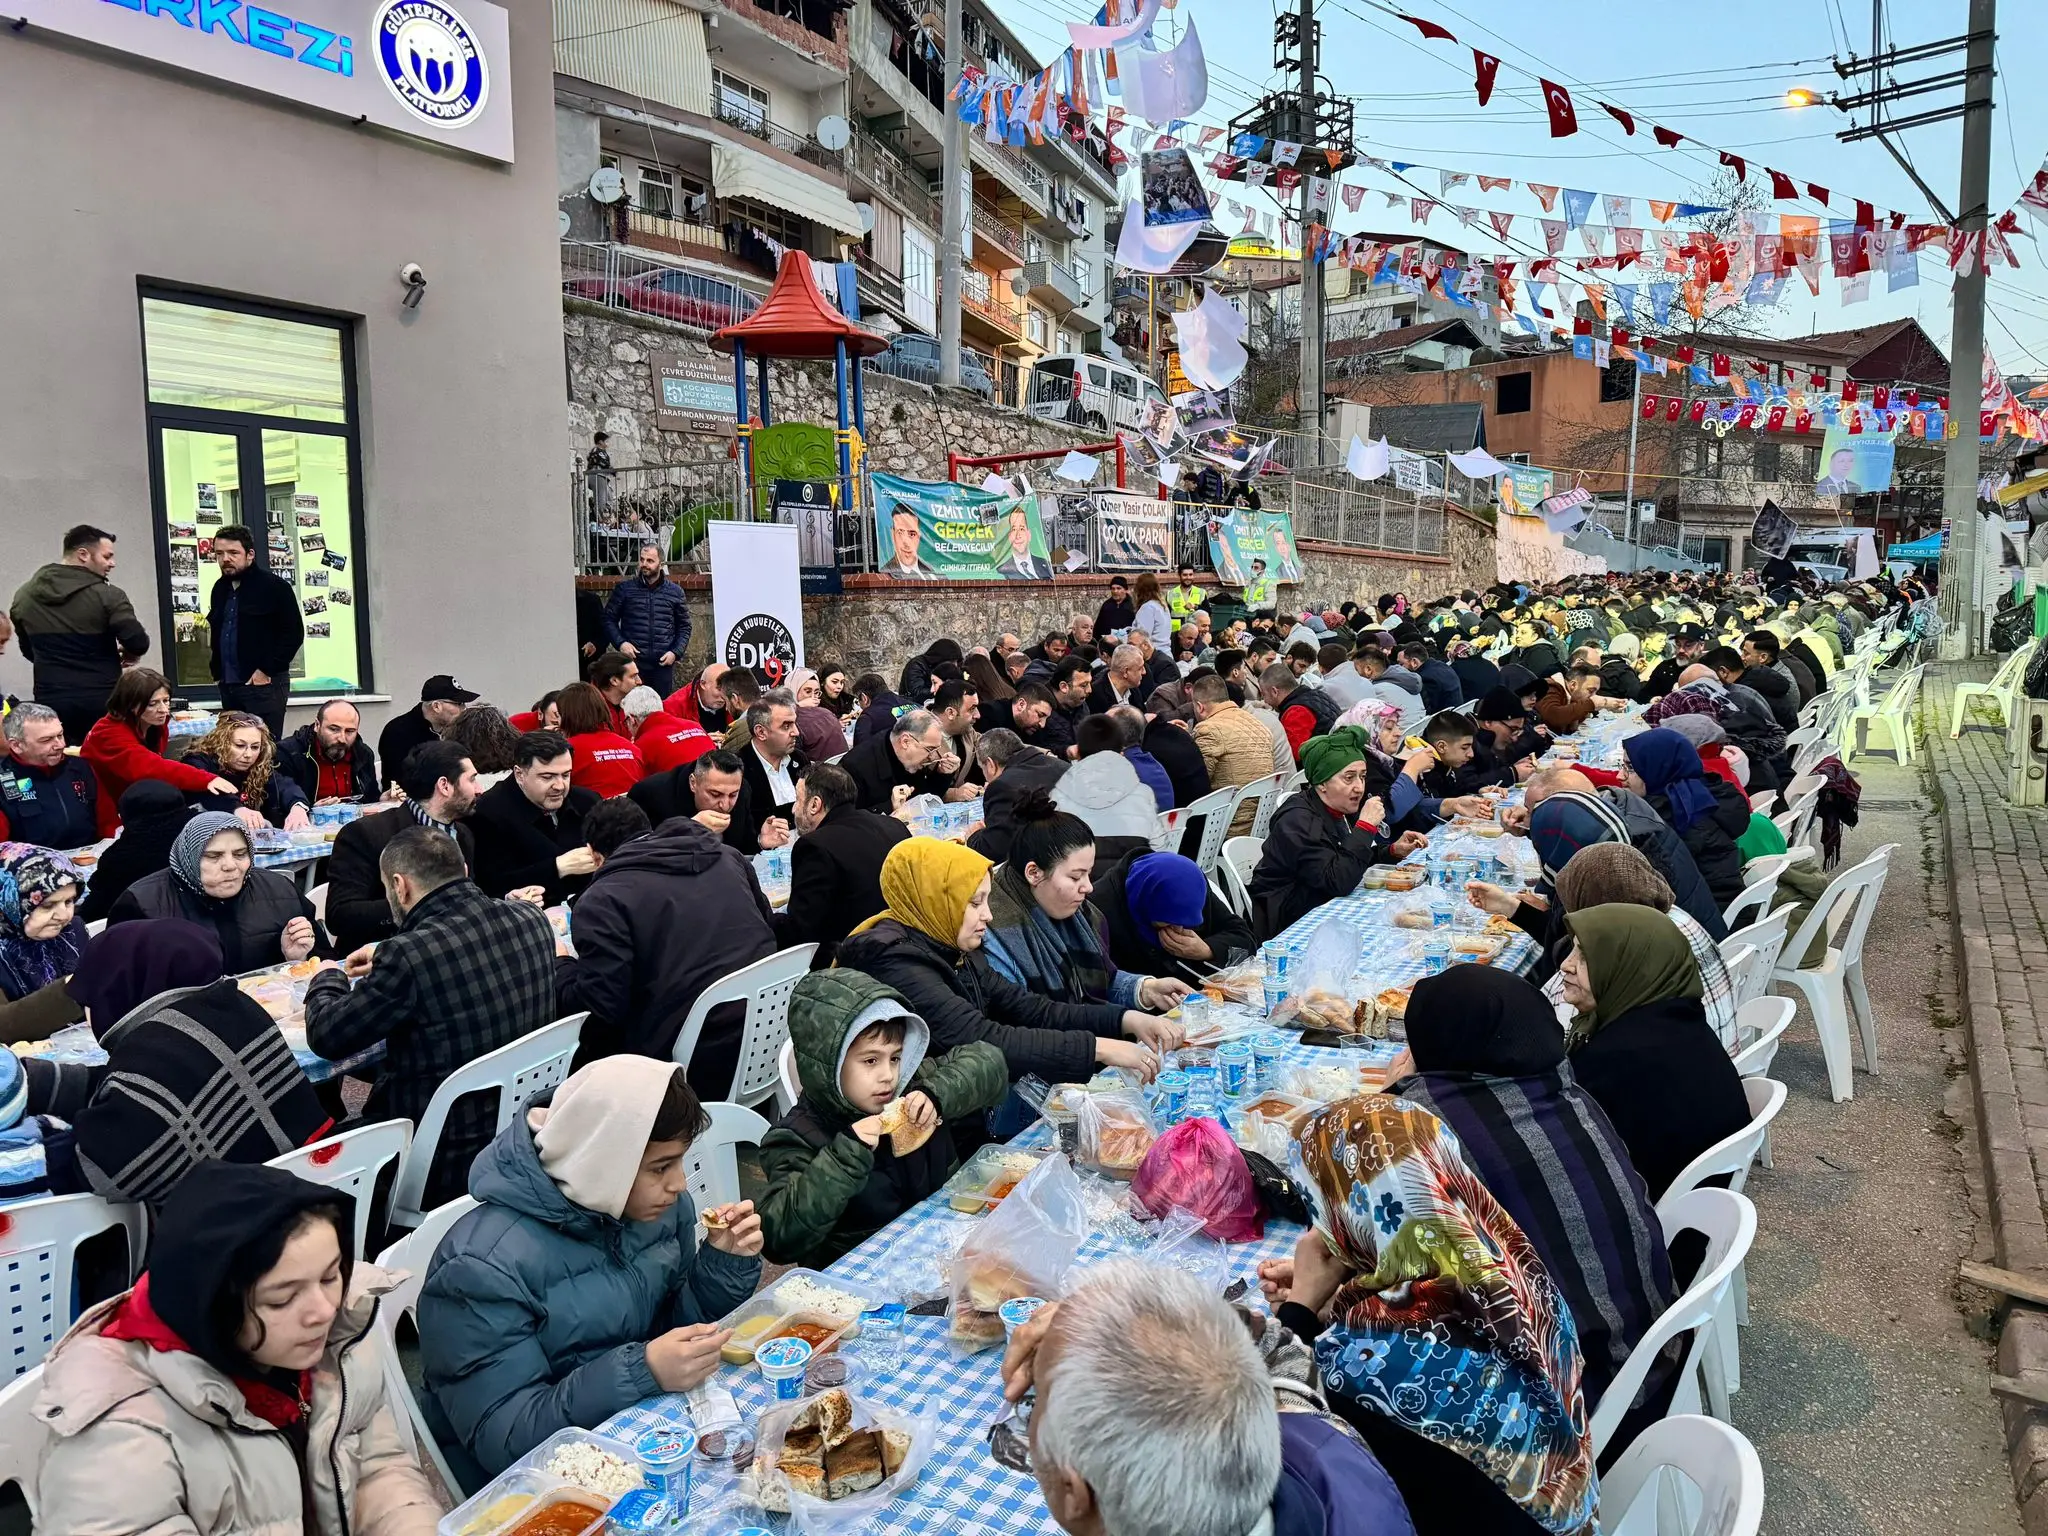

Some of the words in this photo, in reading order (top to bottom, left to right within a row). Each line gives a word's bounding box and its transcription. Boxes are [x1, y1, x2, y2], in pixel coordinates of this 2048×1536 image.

[99, 0, 354, 78] RKEZİ
[385, 3, 475, 61] GÜLTEPELİLER
[394, 75, 472, 117] PLATFORMU
[660, 367, 685, 376] ÇEVRE
[685, 370, 734, 383] DÜZENLEMESİ
[658, 408, 705, 420] TARAFINDAN
[692, 421, 716, 430] 2022
[1101, 495, 1121, 513] Ömer
[1122, 500, 1141, 515] Yasir
[1142, 503, 1167, 518] ÇOLAK
[933, 521, 995, 542] GERÇEK
[1102, 524, 1139, 545] ÇOCUK
[1139, 527, 1167, 546] PARKI
